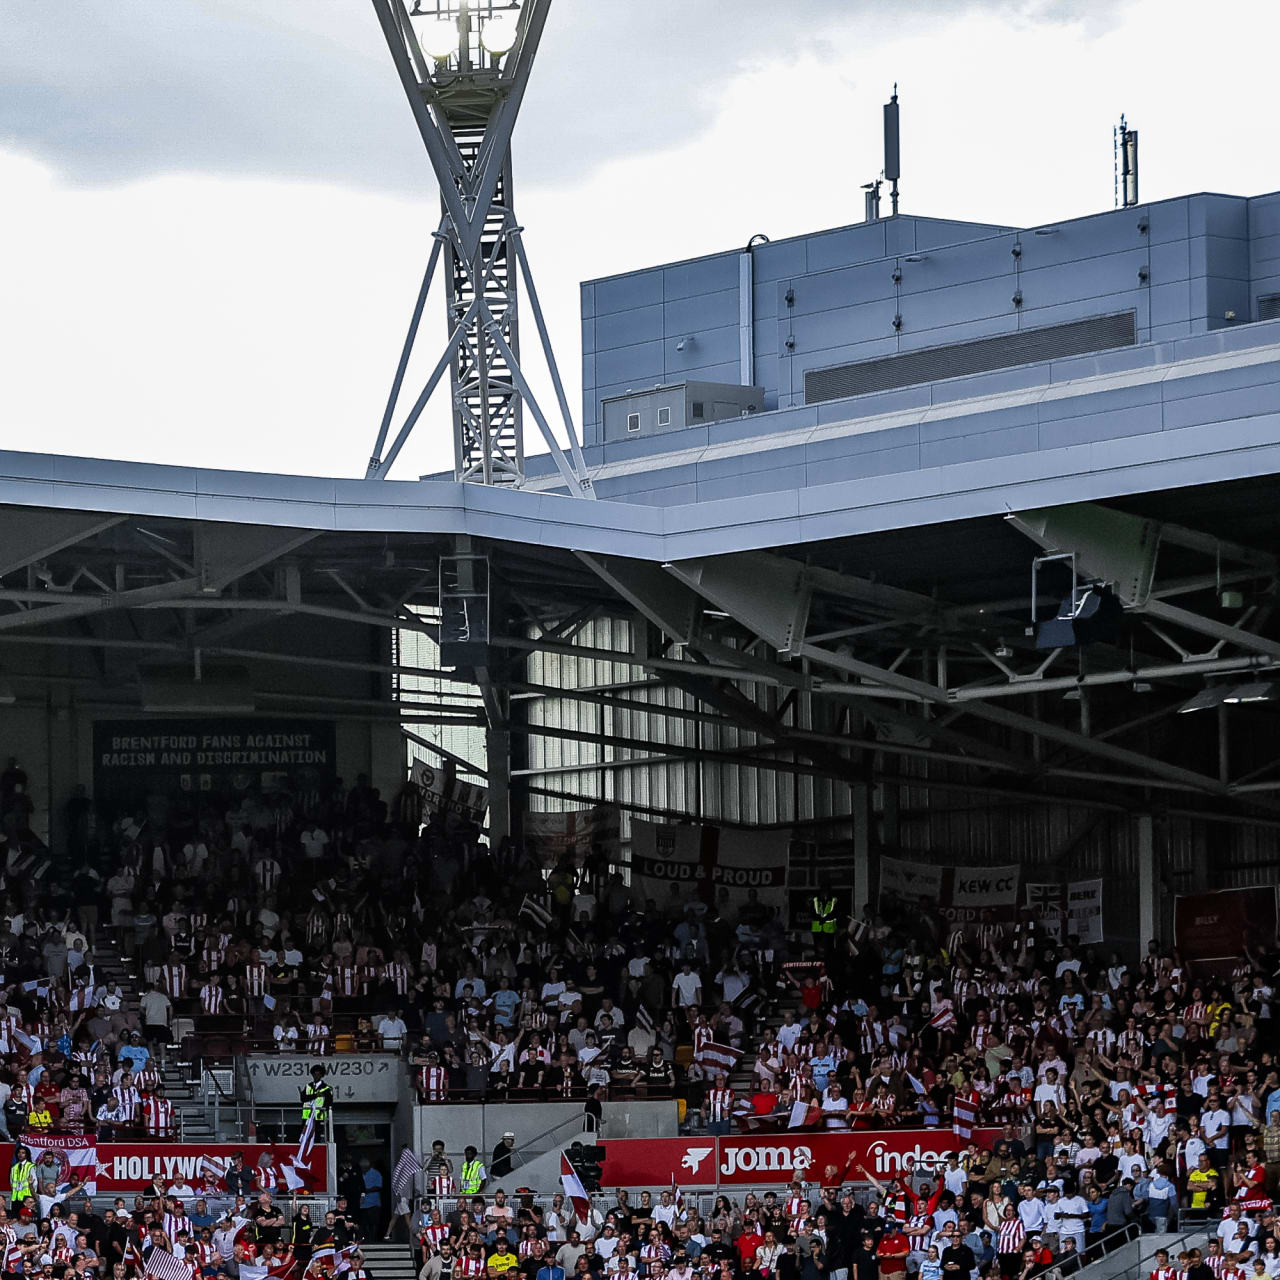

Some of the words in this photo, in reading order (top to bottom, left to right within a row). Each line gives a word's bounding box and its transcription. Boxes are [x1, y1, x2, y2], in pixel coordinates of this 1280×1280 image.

[112, 735, 197, 750] BRENTFORD
[202, 735, 242, 749] FANS
[246, 734, 312, 748] AGAINST
[102, 752, 156, 766] RACISM
[161, 752, 191, 765] AND
[197, 751, 327, 765] DISCRIMINATION
[643, 862, 690, 879] LOUD
[695, 864, 706, 879] &
[712, 867, 773, 885] PROUD
[958, 880, 991, 893] KEW
[264, 1062, 310, 1076] W231
[324, 1061, 374, 1076] W230
[19, 1134, 66, 1147] Brentford
[67, 1138, 90, 1148] DSA
[114, 1156, 235, 1180] HOLLYW
